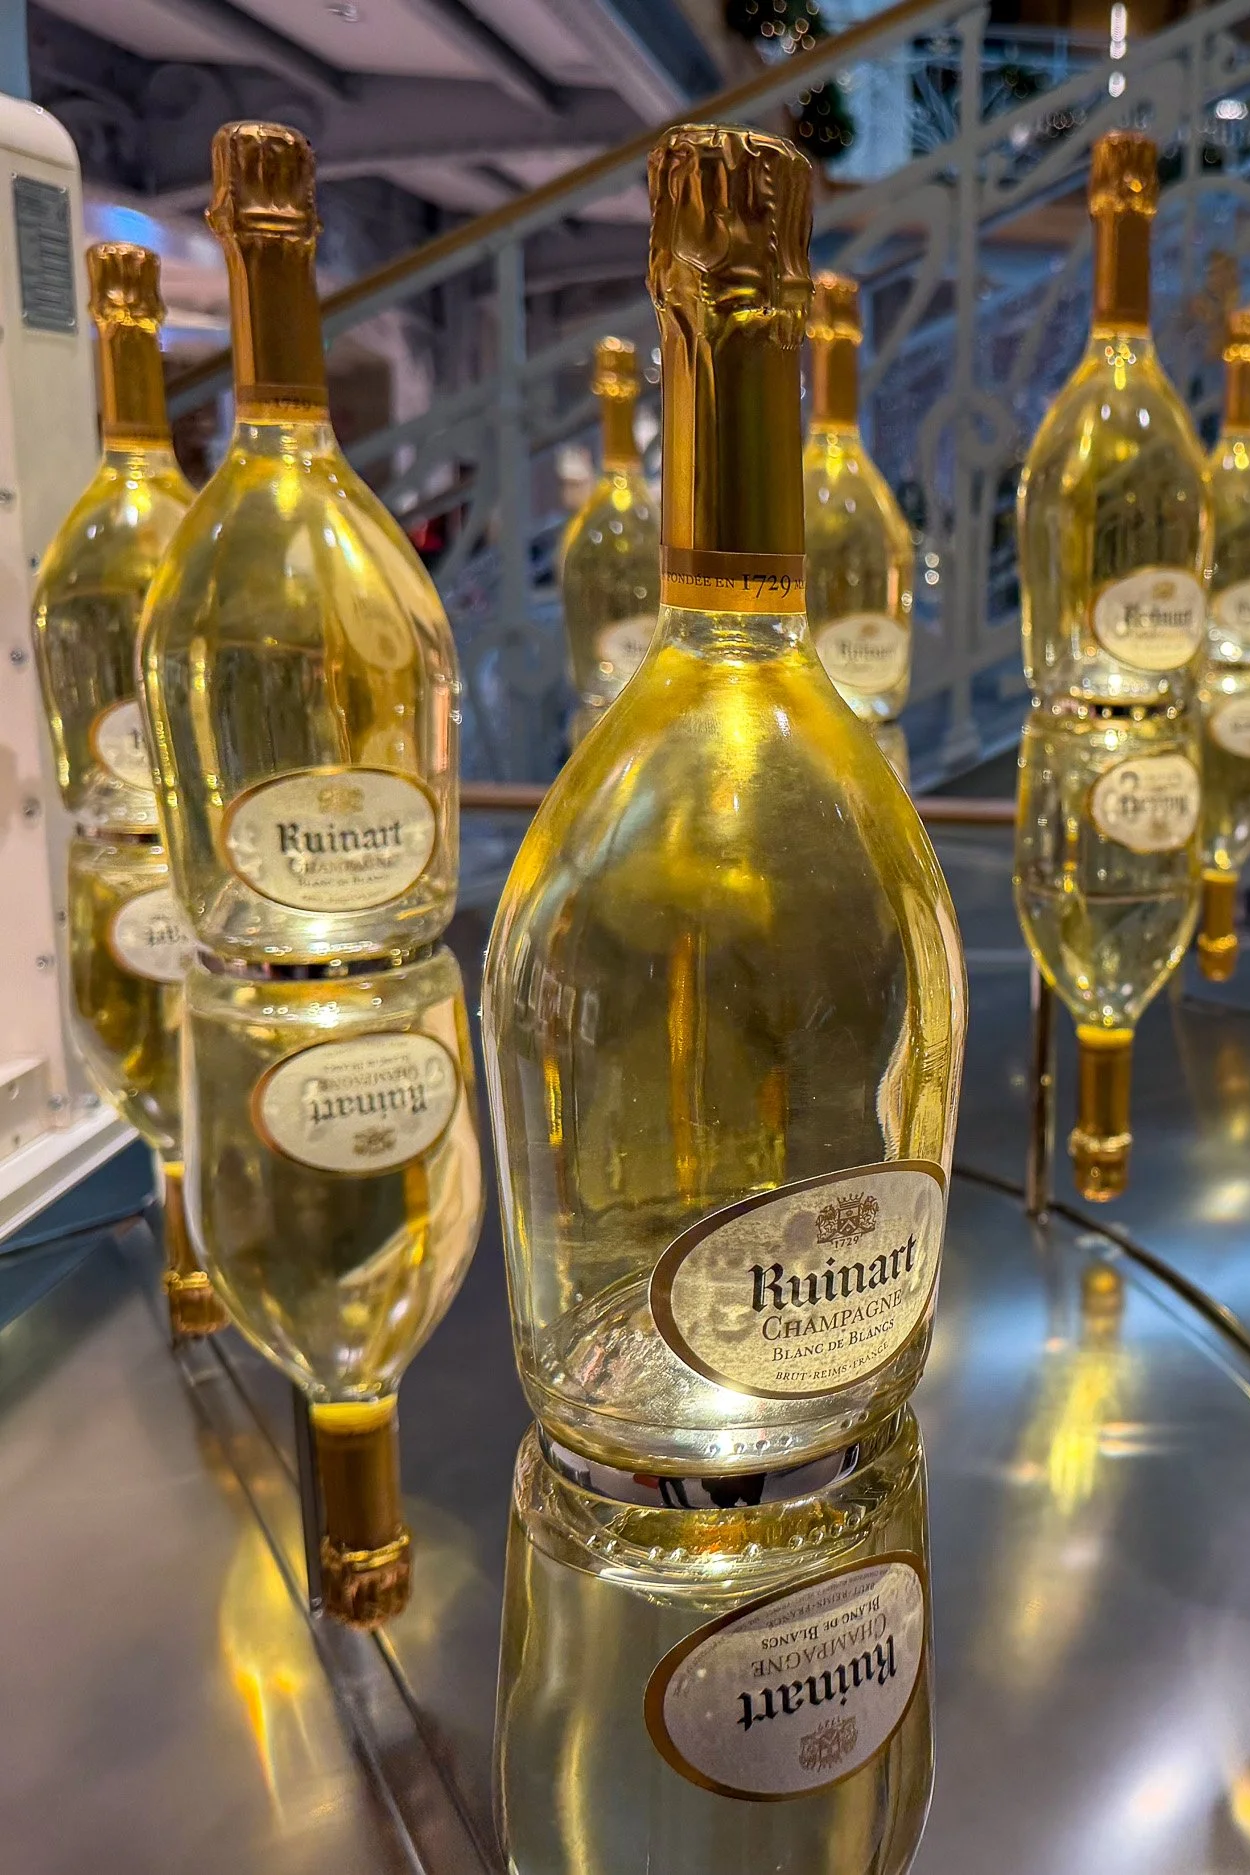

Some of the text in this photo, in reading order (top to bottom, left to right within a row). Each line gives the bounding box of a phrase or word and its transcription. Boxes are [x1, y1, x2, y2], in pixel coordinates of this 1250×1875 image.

[667, 572, 712, 587] FONDÉE
[715, 576, 735, 588] EN
[742, 573, 791, 598] 1729
[277, 820, 401, 854] Ruinart
[310, 1084, 428, 1126] Ruinart
[834, 1236, 860, 1249] 1729
[747, 1233, 917, 1313] Ruinart
[762, 1289, 903, 1341] CHAMPAGNE
[772, 1318, 894, 1362] BLANC DE BLANCS
[823, 1618, 839, 1632] DE
[841, 1595, 880, 1625] BLANC
[751, 1613, 887, 1678] CHAMPAGNE
[761, 1625, 819, 1650] BLANCS
[737, 1634, 898, 1732] Ruinart
